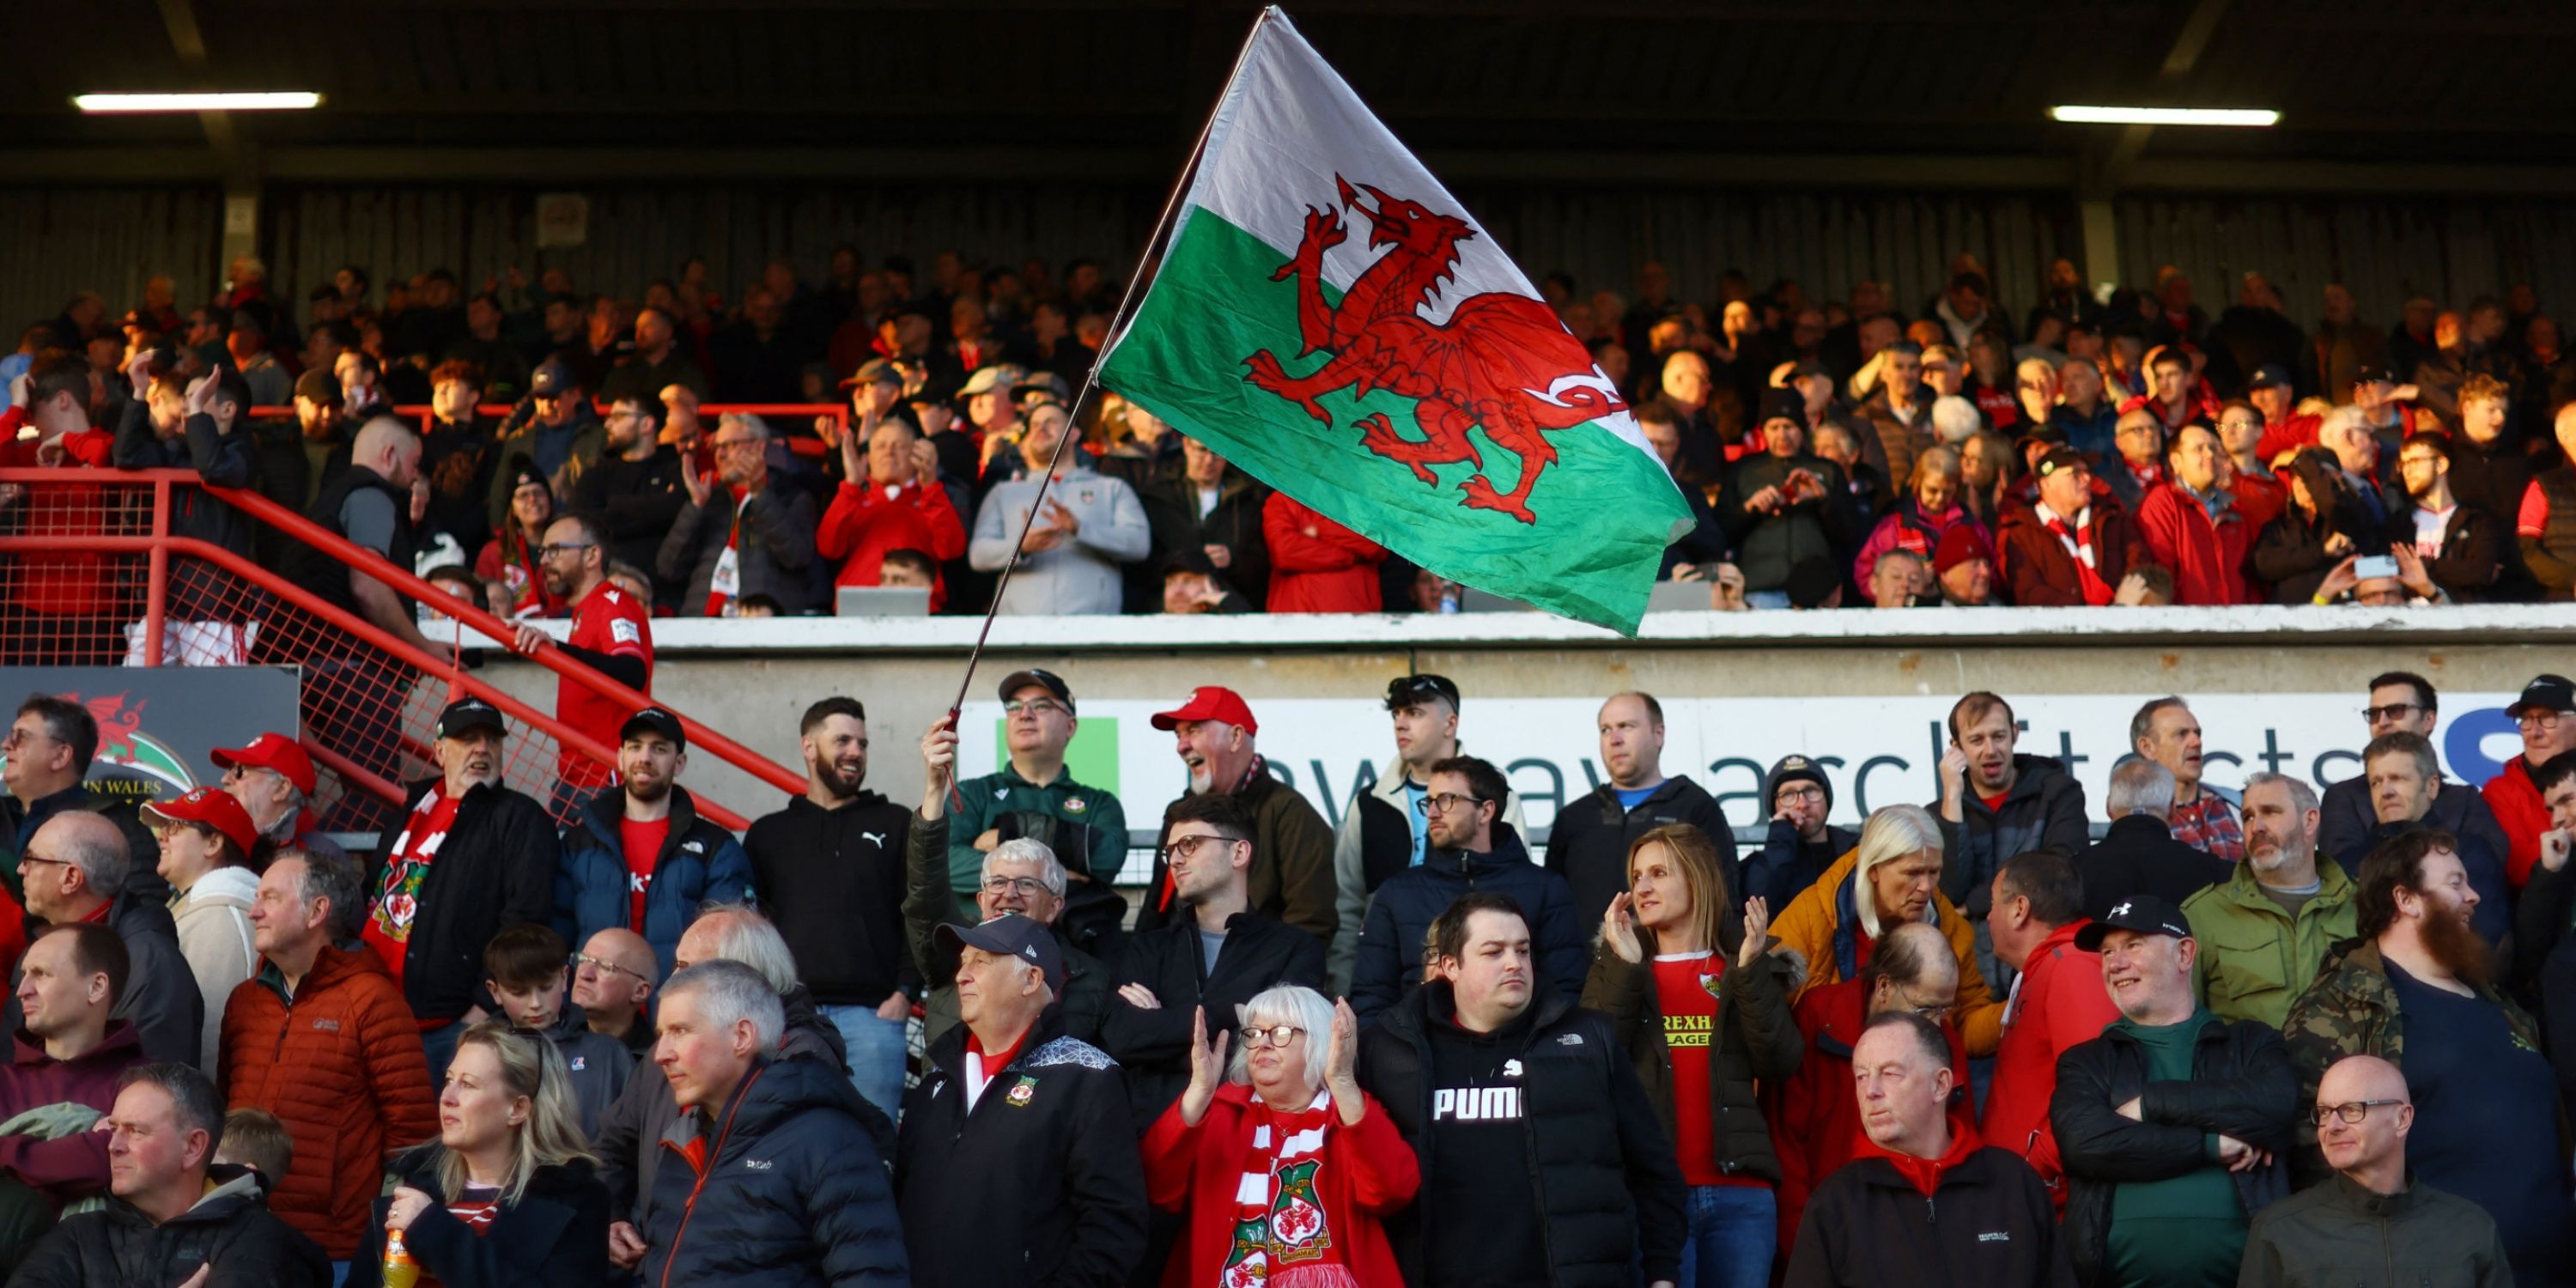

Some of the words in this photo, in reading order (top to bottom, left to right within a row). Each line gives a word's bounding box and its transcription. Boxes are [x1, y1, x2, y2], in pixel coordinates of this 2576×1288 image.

[106, 780, 162, 794] WALES
[1662, 1015, 1714, 1030] REXH
[1666, 1034, 1711, 1045] LAGE
[1434, 1087, 1522, 1121] PUM
